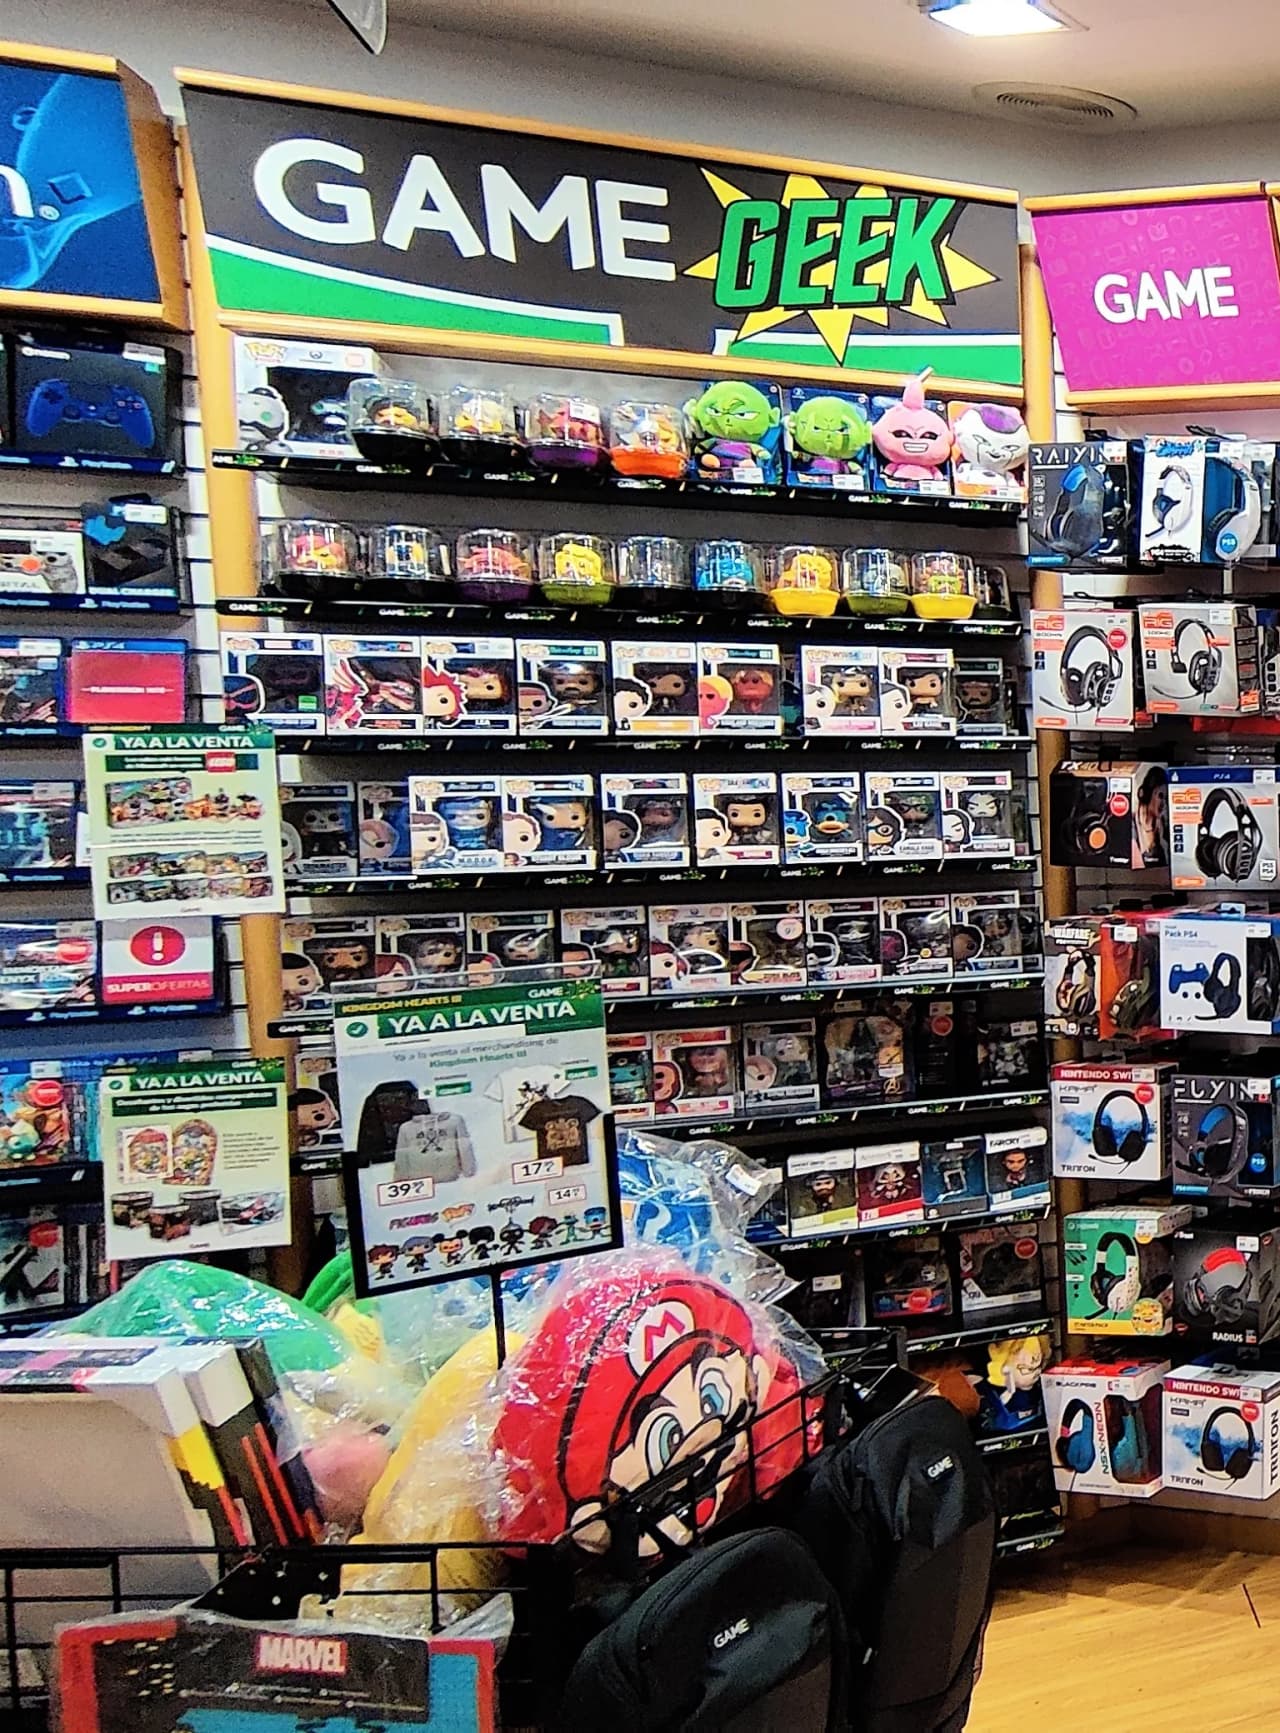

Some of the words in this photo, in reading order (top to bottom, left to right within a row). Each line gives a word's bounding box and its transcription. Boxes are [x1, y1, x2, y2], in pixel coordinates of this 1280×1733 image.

[253, 138, 678, 281] GAME
[714, 197, 957, 308] GEEK
[1093, 266, 1239, 324] GAME
[1143, 614, 1174, 629] RIG
[121, 736, 145, 749] YA
[146, 736, 164, 748] A
[166, 736, 191, 748] LA
[193, 736, 254, 748] VENTA
[1165, 930, 1181, 938] Pack
[1183, 931, 1198, 939] PS4
[107, 979, 209, 994] SUPEROFERTAS
[528, 986, 564, 999] GAME
[342, 1001, 402, 1013] KINGDOM
[404, 996, 448, 1008] HEARTS
[389, 1015, 427, 1034] YA
[429, 1012, 450, 1030] A
[454, 1009, 491, 1028] LA
[494, 1001, 576, 1024] VENTA
[137, 1077, 162, 1089] YA
[163, 1076, 180, 1088] A
[181, 1074, 204, 1086] LA
[205, 1071, 266, 1085] VENTA
[1061, 1069, 1110, 1079] NINTENDO
[1061, 1164, 1096, 1173] TRITTON
[644, 1309, 685, 1362] M
[1212, 1332, 1243, 1341] RADIUS
[1172, 1381, 1220, 1395] NINTENDO
[1269, 1409, 1279, 1485] TRITTON
[927, 1456, 953, 1479] GAME
[1170, 1474, 1204, 1486] TRITTON
[714, 1618, 750, 1649] GAME
[259, 1638, 345, 1673] MARVEL
